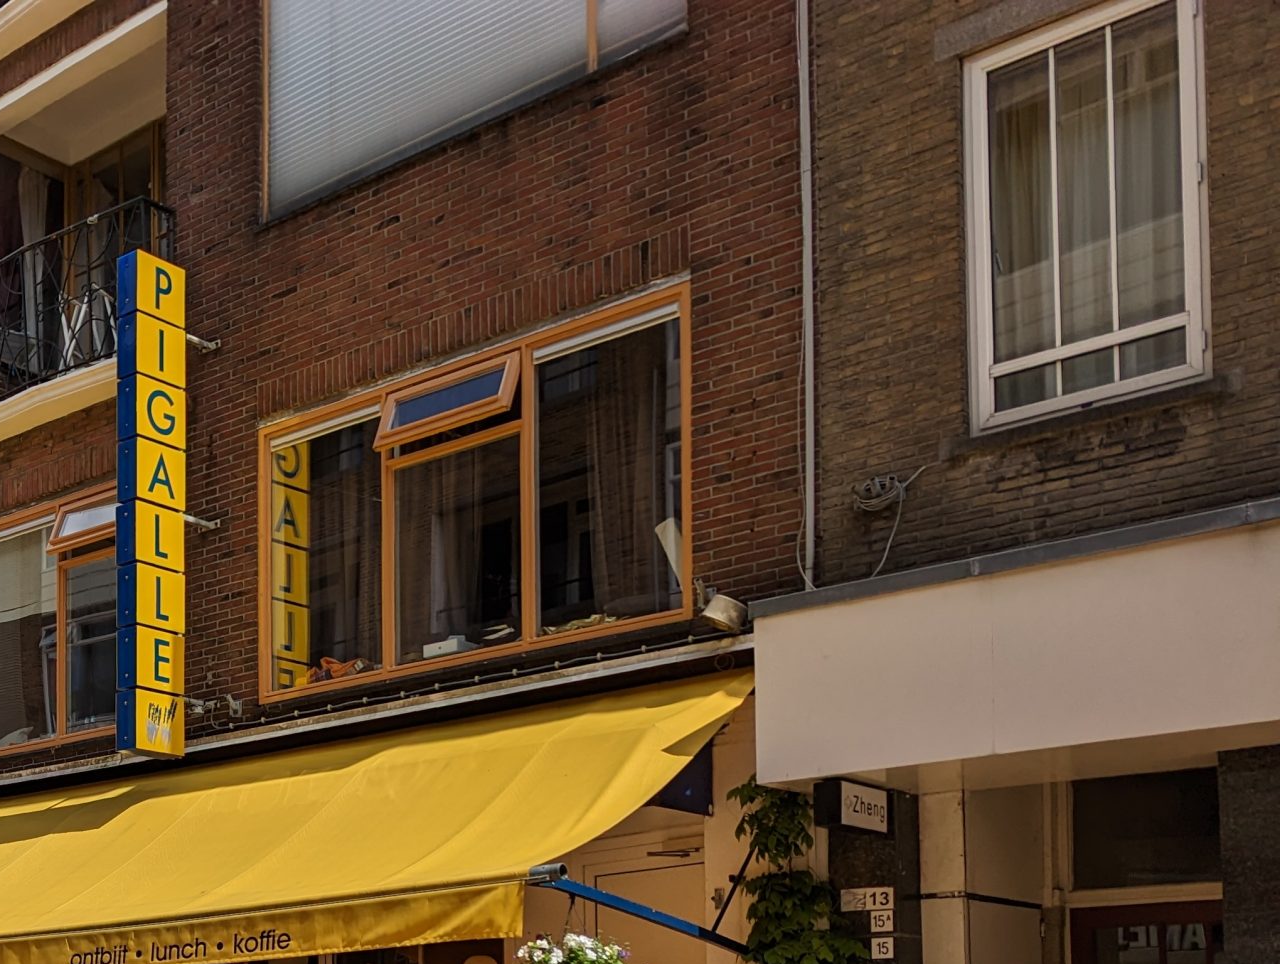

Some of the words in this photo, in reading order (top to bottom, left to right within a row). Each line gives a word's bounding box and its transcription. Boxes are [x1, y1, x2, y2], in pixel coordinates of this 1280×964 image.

[146, 266, 176, 684] PIGALLE
[852, 795, 885, 824] Zheng
[870, 891, 889, 906] 13
[150, 938, 207, 962] lunch
[233, 929, 291, 954] koffie
[876, 941, 889, 955] 15
